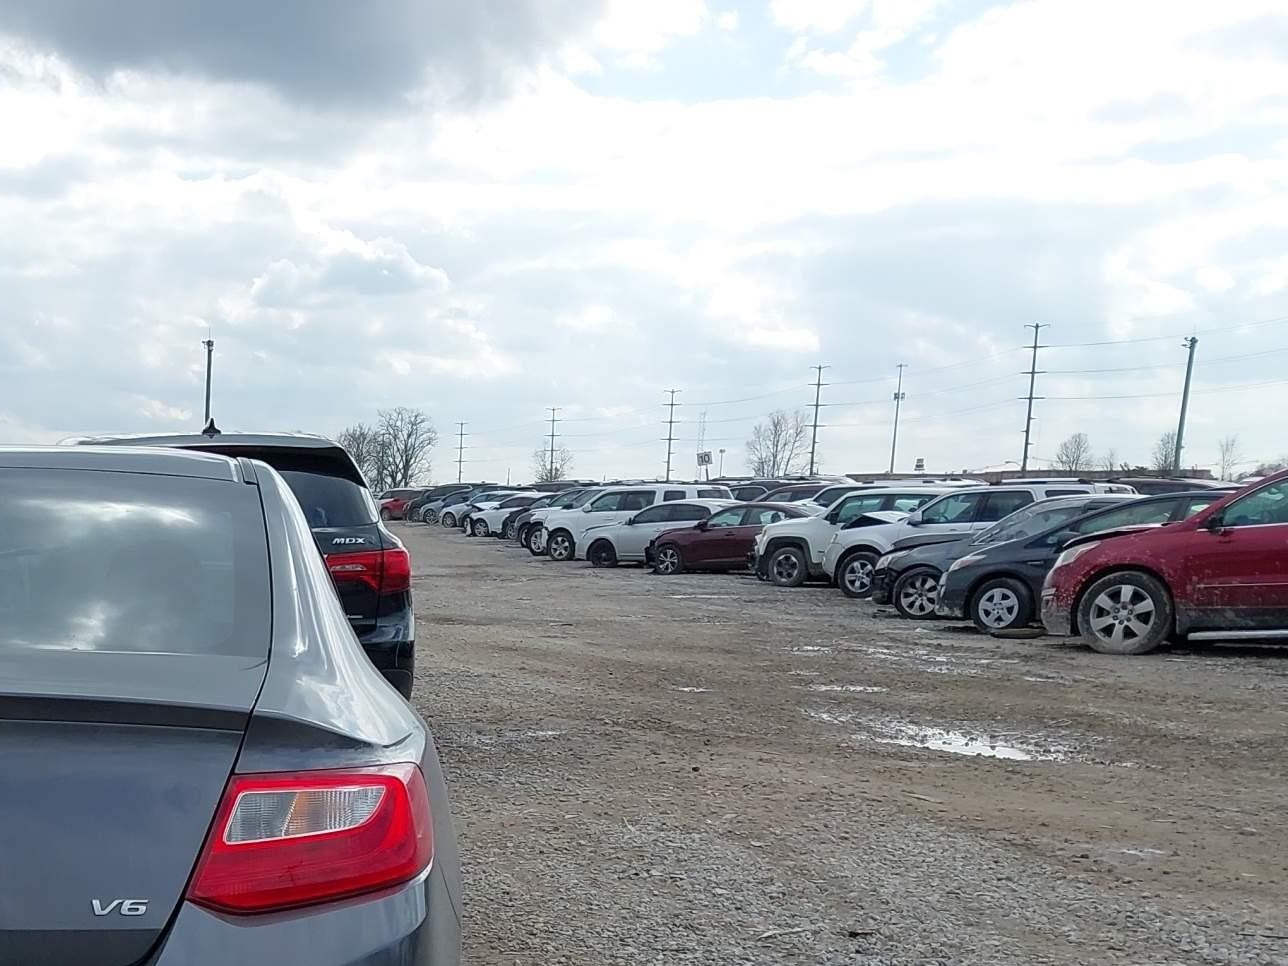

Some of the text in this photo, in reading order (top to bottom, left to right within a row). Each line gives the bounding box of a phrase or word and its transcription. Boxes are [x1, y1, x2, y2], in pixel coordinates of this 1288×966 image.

[699, 454, 710, 464] 10
[332, 537, 366, 545] MDX
[92, 899, 149, 916] V6
